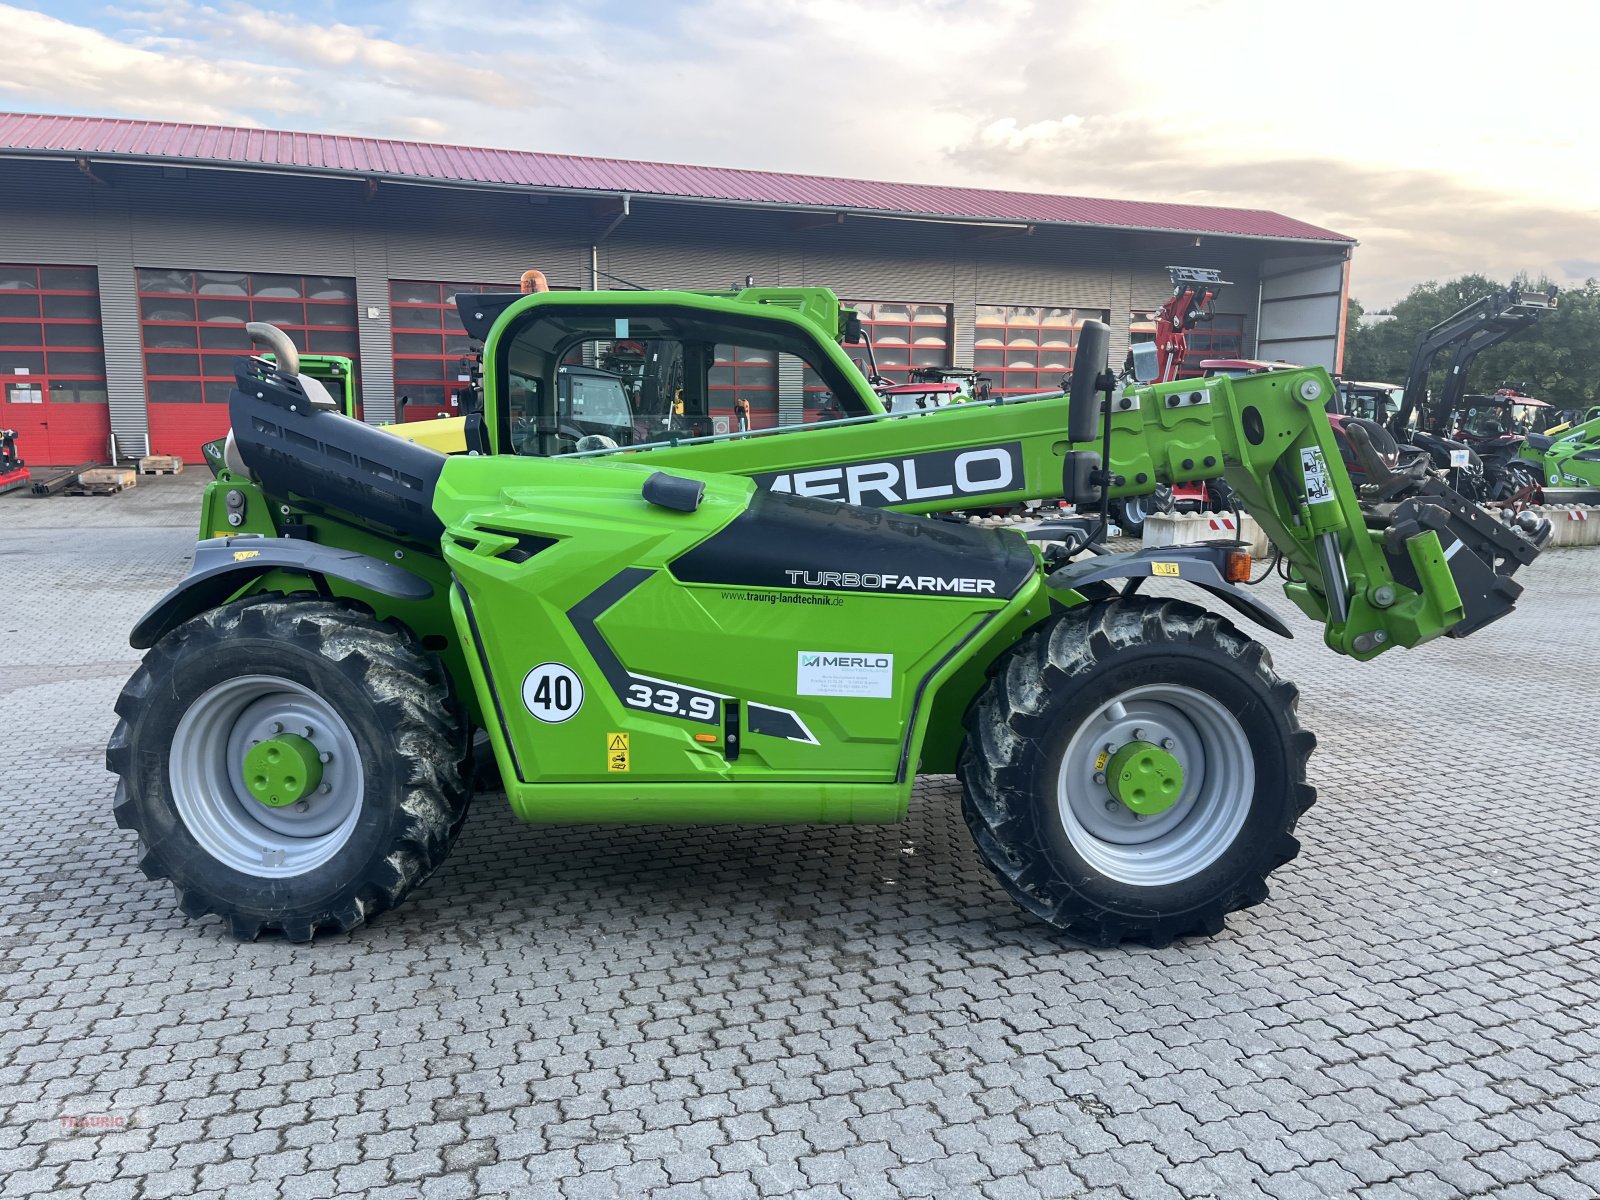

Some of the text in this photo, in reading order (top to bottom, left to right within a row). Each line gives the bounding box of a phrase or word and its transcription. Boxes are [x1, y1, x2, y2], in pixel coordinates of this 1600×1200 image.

[769, 447, 1013, 507] ERLO
[785, 569, 995, 594] TURBOFARMER
[721, 591, 844, 607] www.traurig-landtechnik.de
[823, 657, 889, 668] MERLO
[533, 675, 572, 711] 40
[626, 684, 715, 720] 33.9
